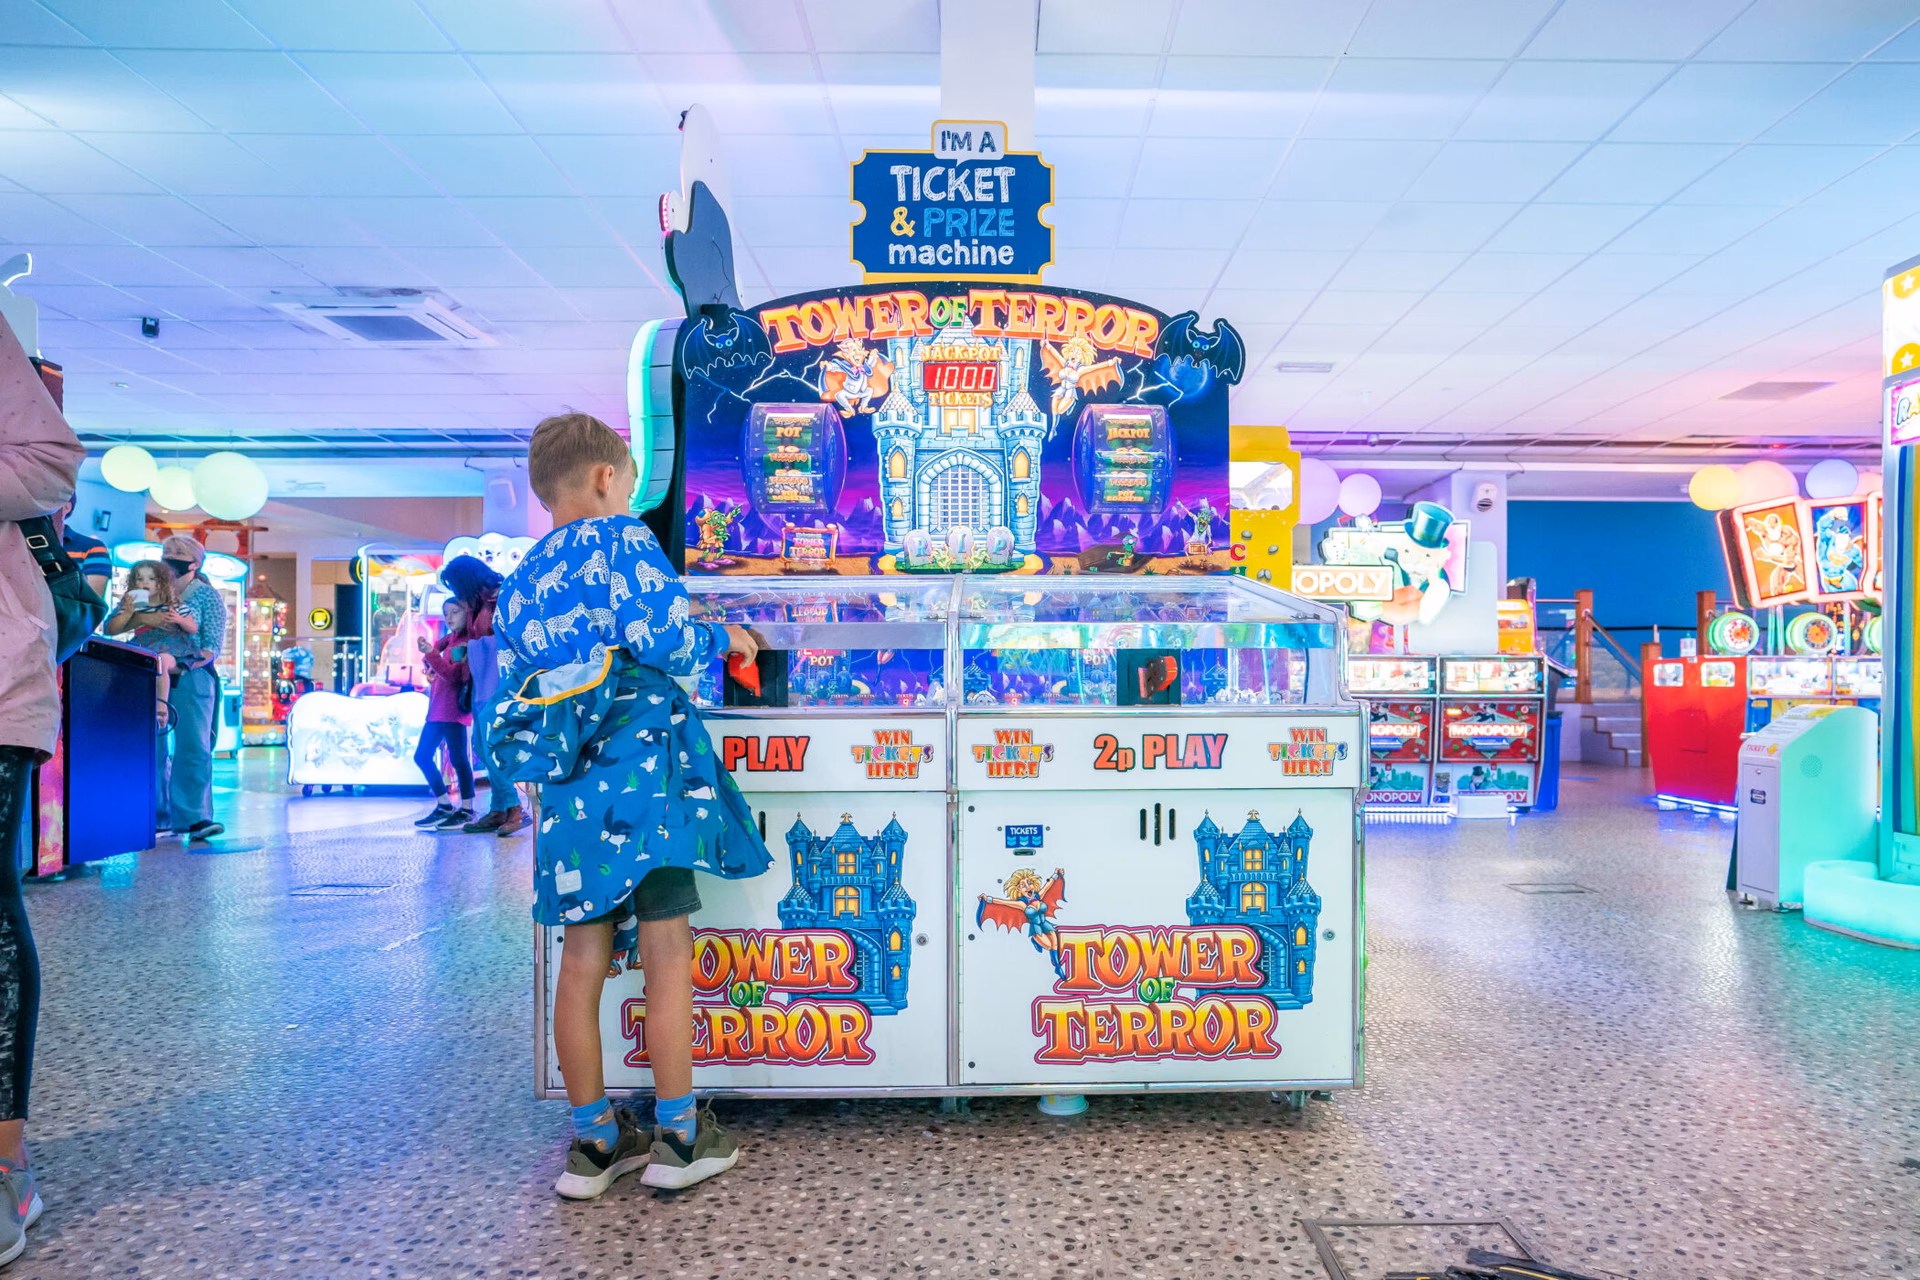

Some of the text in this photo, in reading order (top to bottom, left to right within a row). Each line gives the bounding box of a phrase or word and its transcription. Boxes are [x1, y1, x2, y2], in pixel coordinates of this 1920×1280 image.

[940, 130, 997, 153] I'M A
[889, 164, 1016, 203] TICKET
[890, 205, 1016, 238] & PRIZE
[888, 239, 1015, 266] machine
[760, 288, 1160, 360] TOWER OF TERROR
[922, 345, 1003, 362] JACKPOT
[934, 366, 997, 390] 1000
[927, 391, 994, 408] TICKETS
[775, 425, 803, 439] POT
[1106, 427, 1151, 441] JACKPOT
[1292, 570, 1385, 595] OPOLY
[809, 655, 835, 667] POT
[1083, 654, 1109, 666] POT
[873, 729, 912, 746] WIN
[993, 728, 1033, 745] WIN
[1288, 727, 1327, 743] WIN
[1451, 724, 1526, 737] MONOPOLY
[723, 735, 810, 772] PLAY
[851, 744, 934, 764] TICKETS
[971, 743, 1054, 763] TICKETS
[1093, 733, 1229, 772] 2p PLAY
[1267, 742, 1349, 761] TICKETS
[866, 761, 919, 779] HERE
[986, 761, 1040, 779] HERE
[1282, 759, 1334, 777] HERE
[1010, 826, 1038, 836] TICKETS
[691, 929, 858, 992] OWER
[1056, 925, 1263, 993] TOWER
[730, 979, 767, 1007] OF
[1138, 976, 1175, 1004] OF
[1034, 996, 1280, 1063] TERROR
